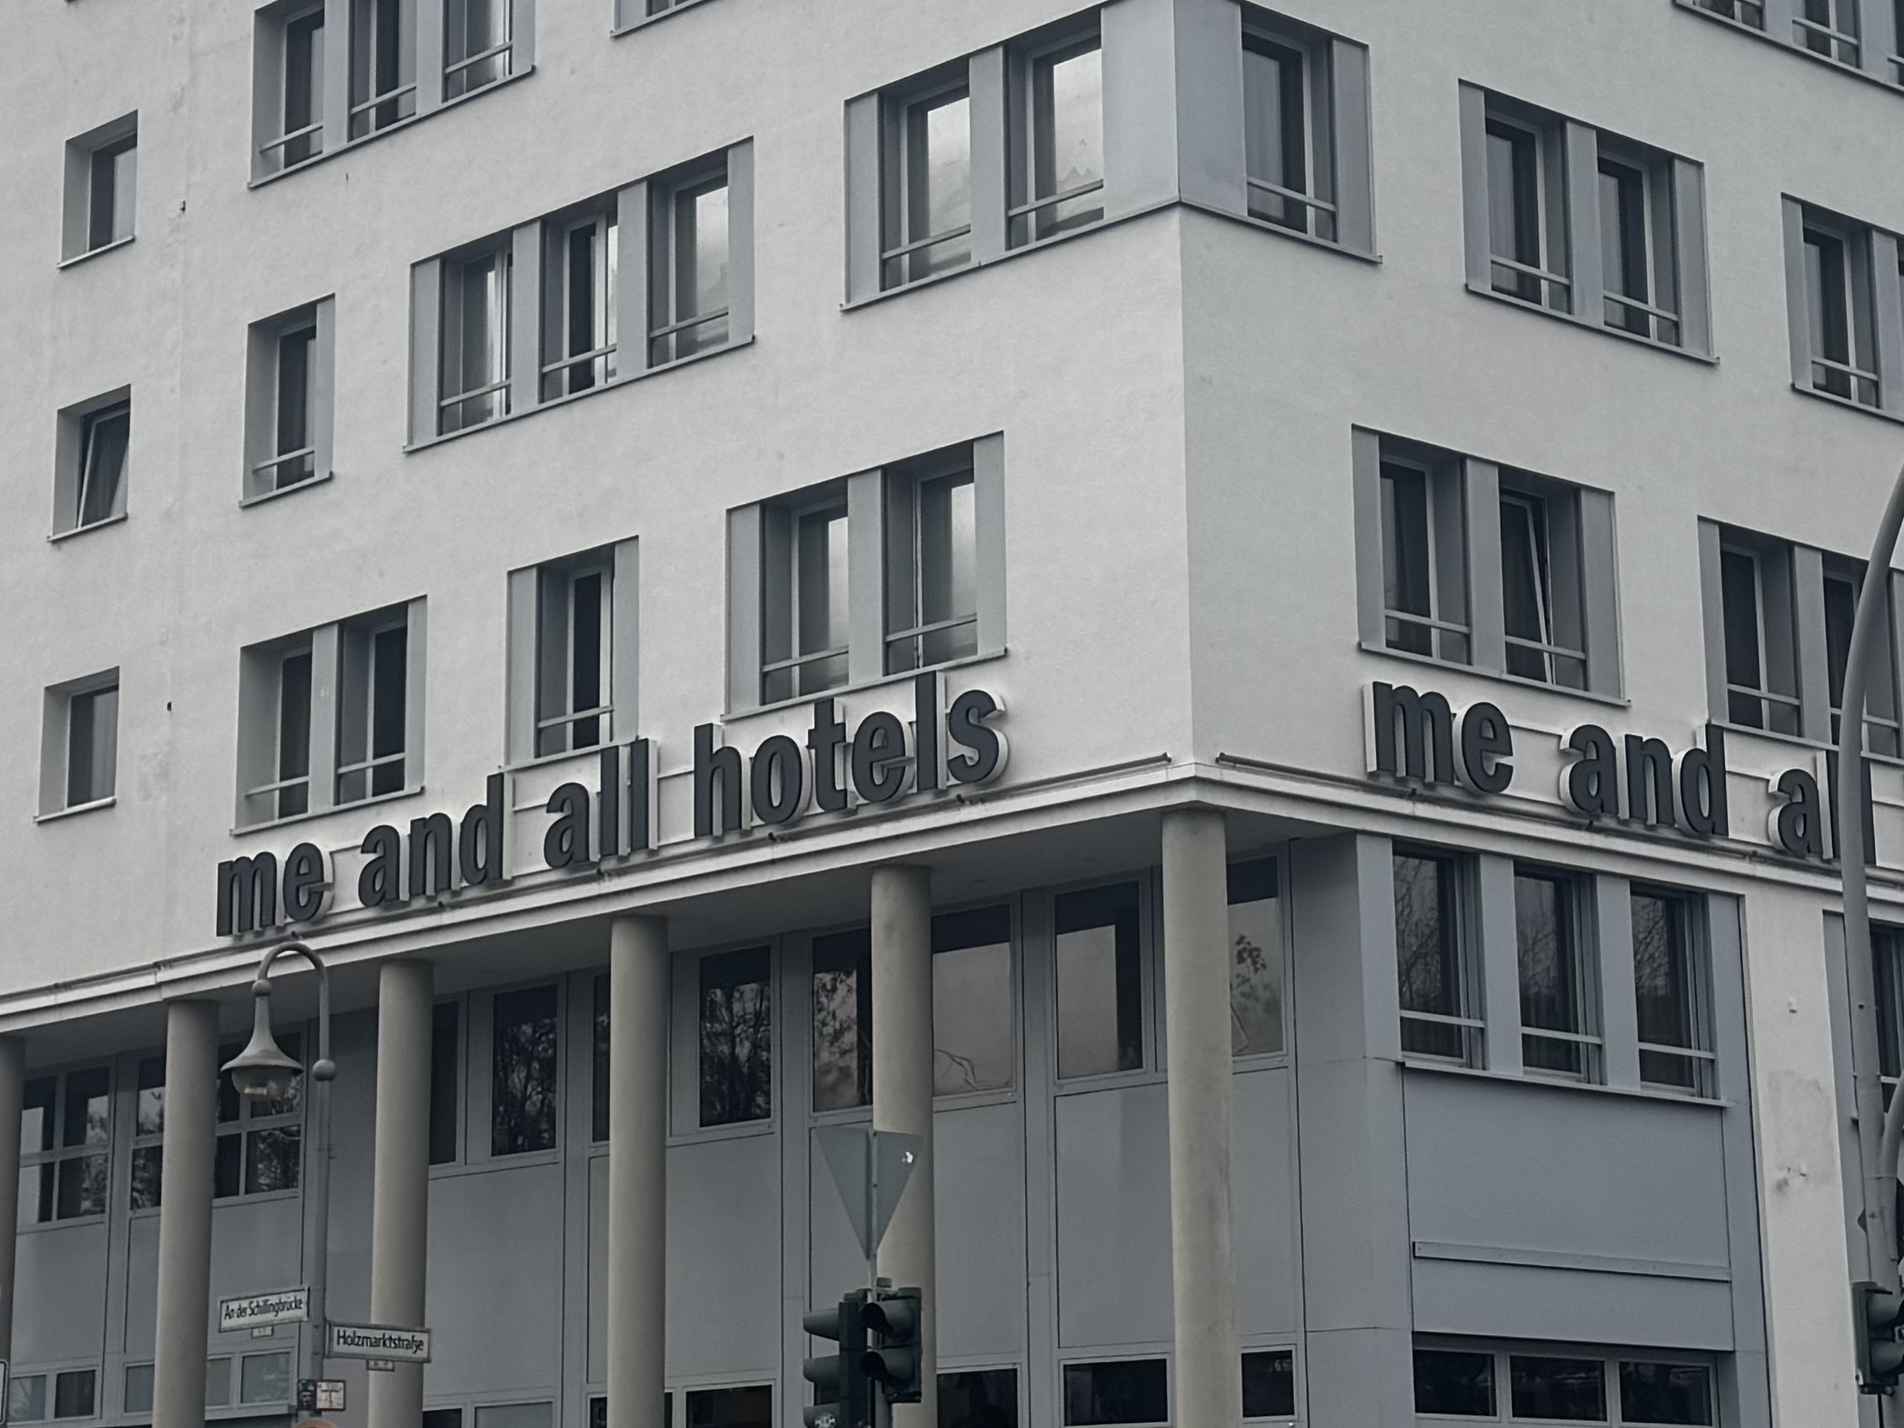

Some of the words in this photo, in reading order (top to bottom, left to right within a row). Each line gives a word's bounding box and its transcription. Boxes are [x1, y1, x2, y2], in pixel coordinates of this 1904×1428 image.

[216, 841, 333, 937] me
[358, 772, 512, 908] and
[543, 737, 659, 870] all
[694, 671, 1010, 839] hotels
[1364, 681, 1514, 795] me
[1560, 723, 1728, 837] and
[224, 1304, 235, 1320] An
[236, 1302, 247, 1318] der
[248, 1295, 304, 1317] Schillingbrücke
[337, 1329, 424, 1354] Holzmarktstraße
